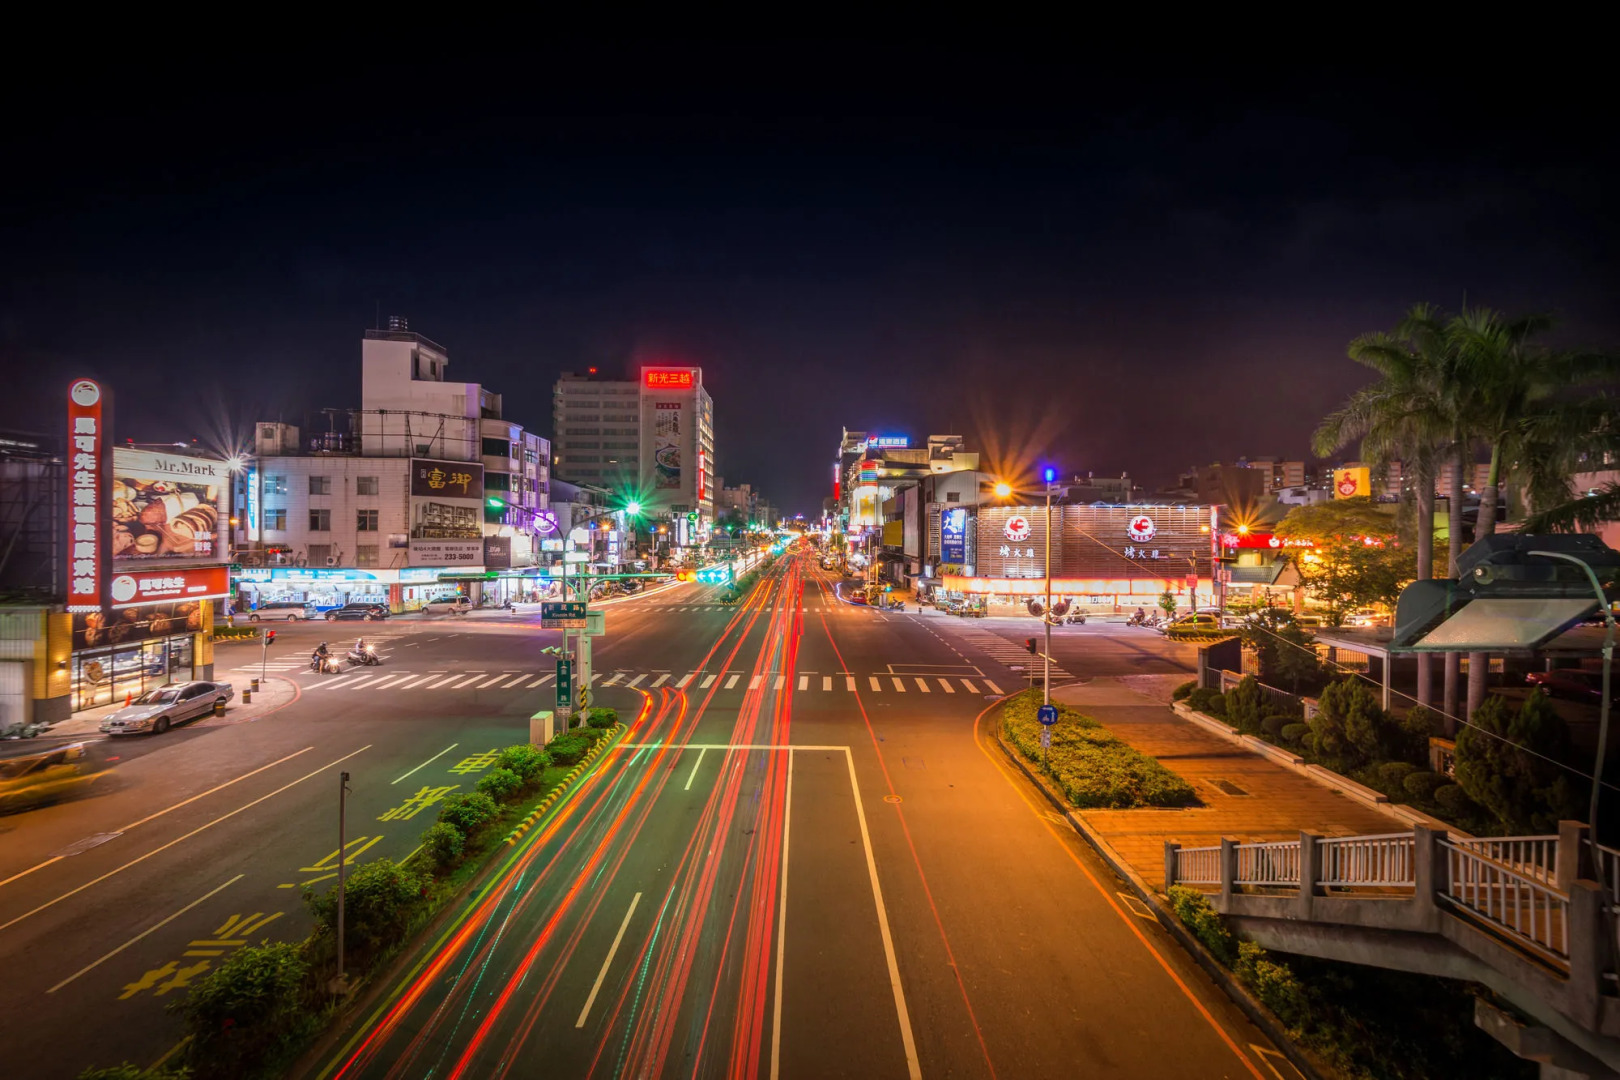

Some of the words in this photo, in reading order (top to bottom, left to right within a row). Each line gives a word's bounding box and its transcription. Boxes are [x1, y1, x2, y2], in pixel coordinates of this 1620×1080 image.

[647, 372, 690, 384] 新光三越
[154, 458, 216, 477] Mr.Mark
[427, 467, 472, 494] 富御
